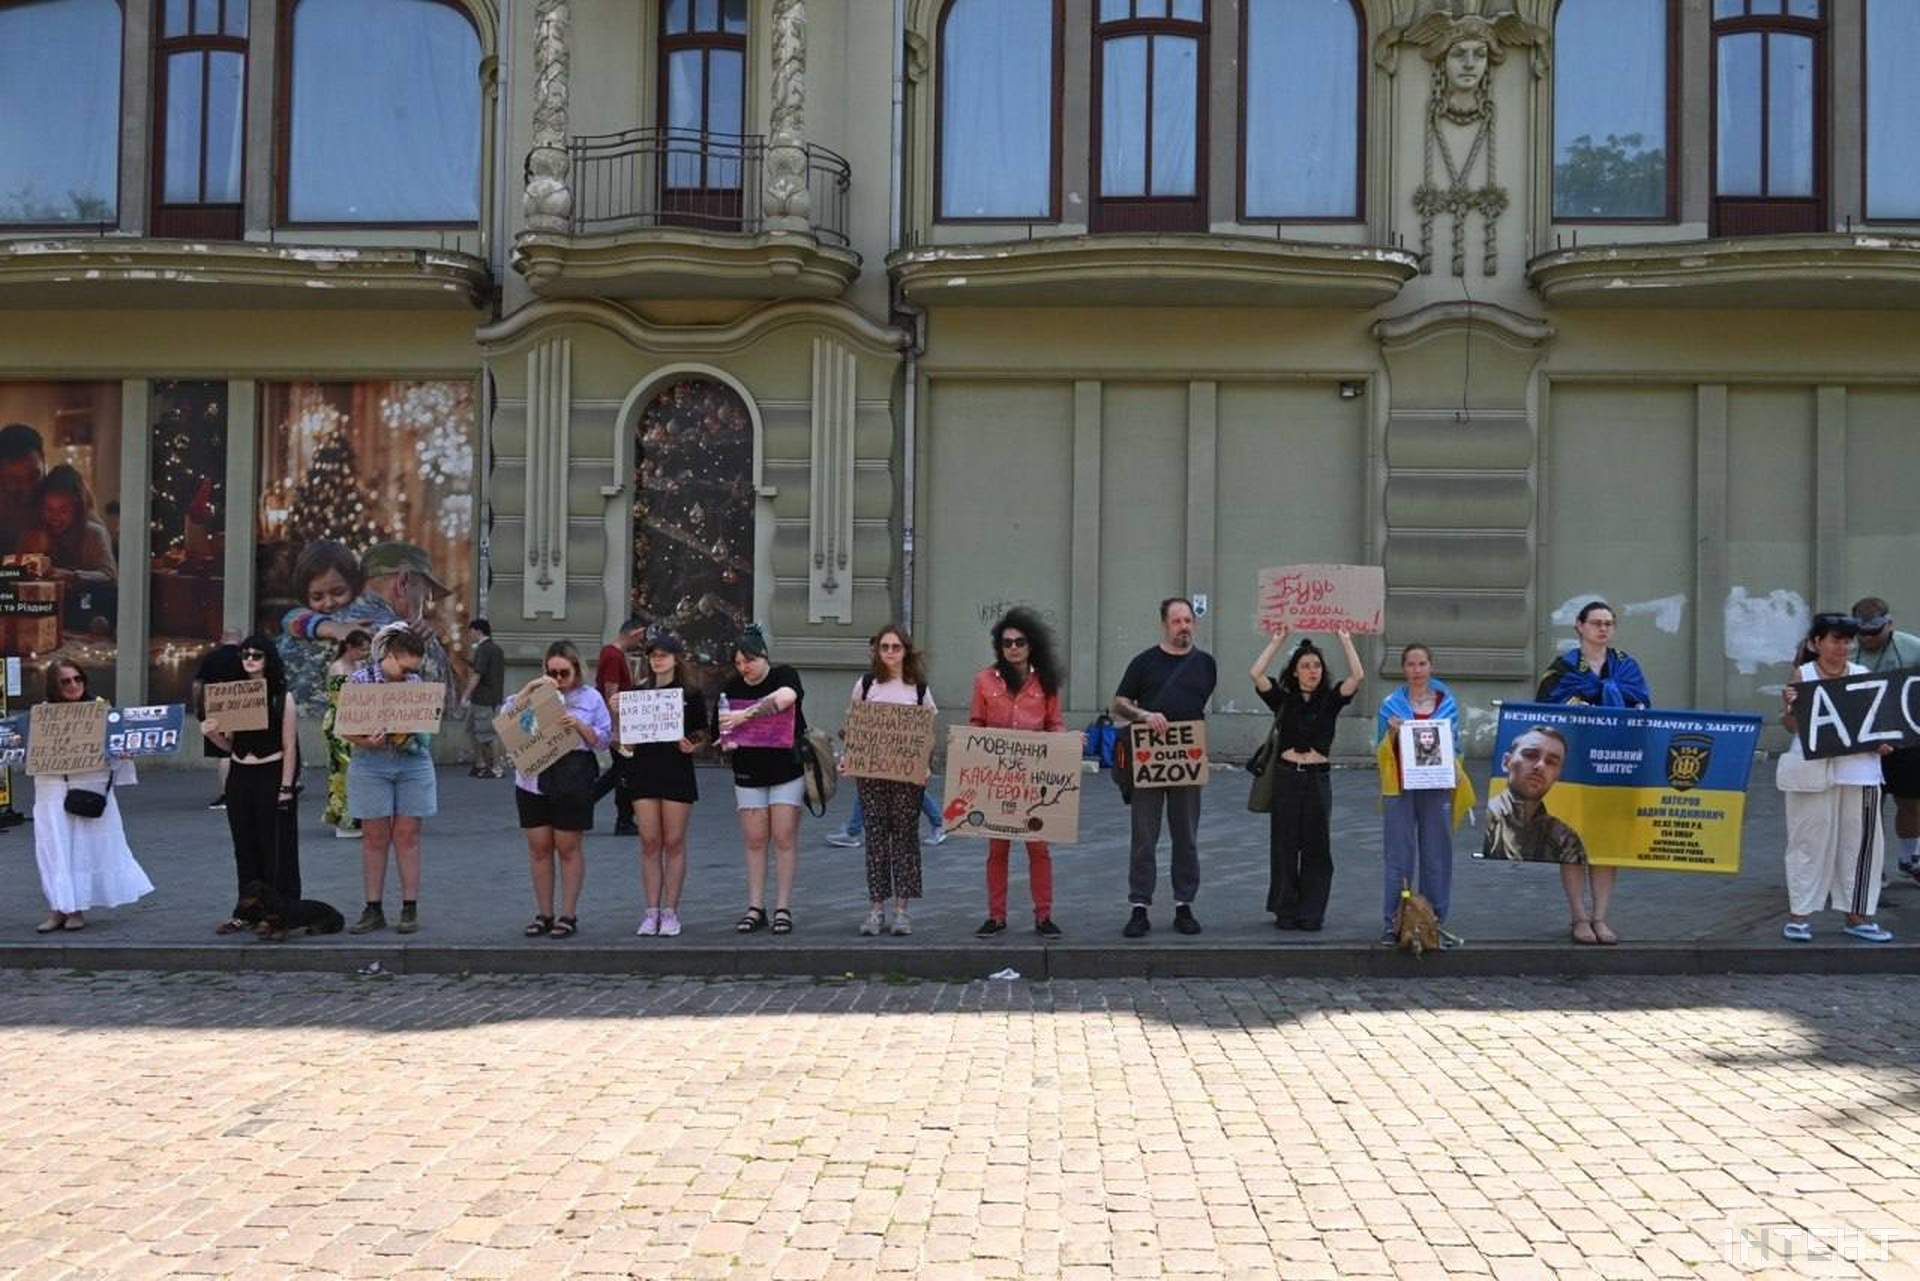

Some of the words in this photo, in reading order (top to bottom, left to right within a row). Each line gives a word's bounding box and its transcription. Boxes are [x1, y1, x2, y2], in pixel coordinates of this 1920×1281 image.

[966, 734, 1048, 759] МОВЧАННЯ
[1134, 726, 1194, 748] FREE
[849, 756, 865, 770] НА
[868, 759, 914, 776] ВОЛЮ
[998, 755, 1027, 772] КУЄ
[1136, 763, 1202, 783] AZOV
[1031, 771, 1074, 787] НАШИХ
